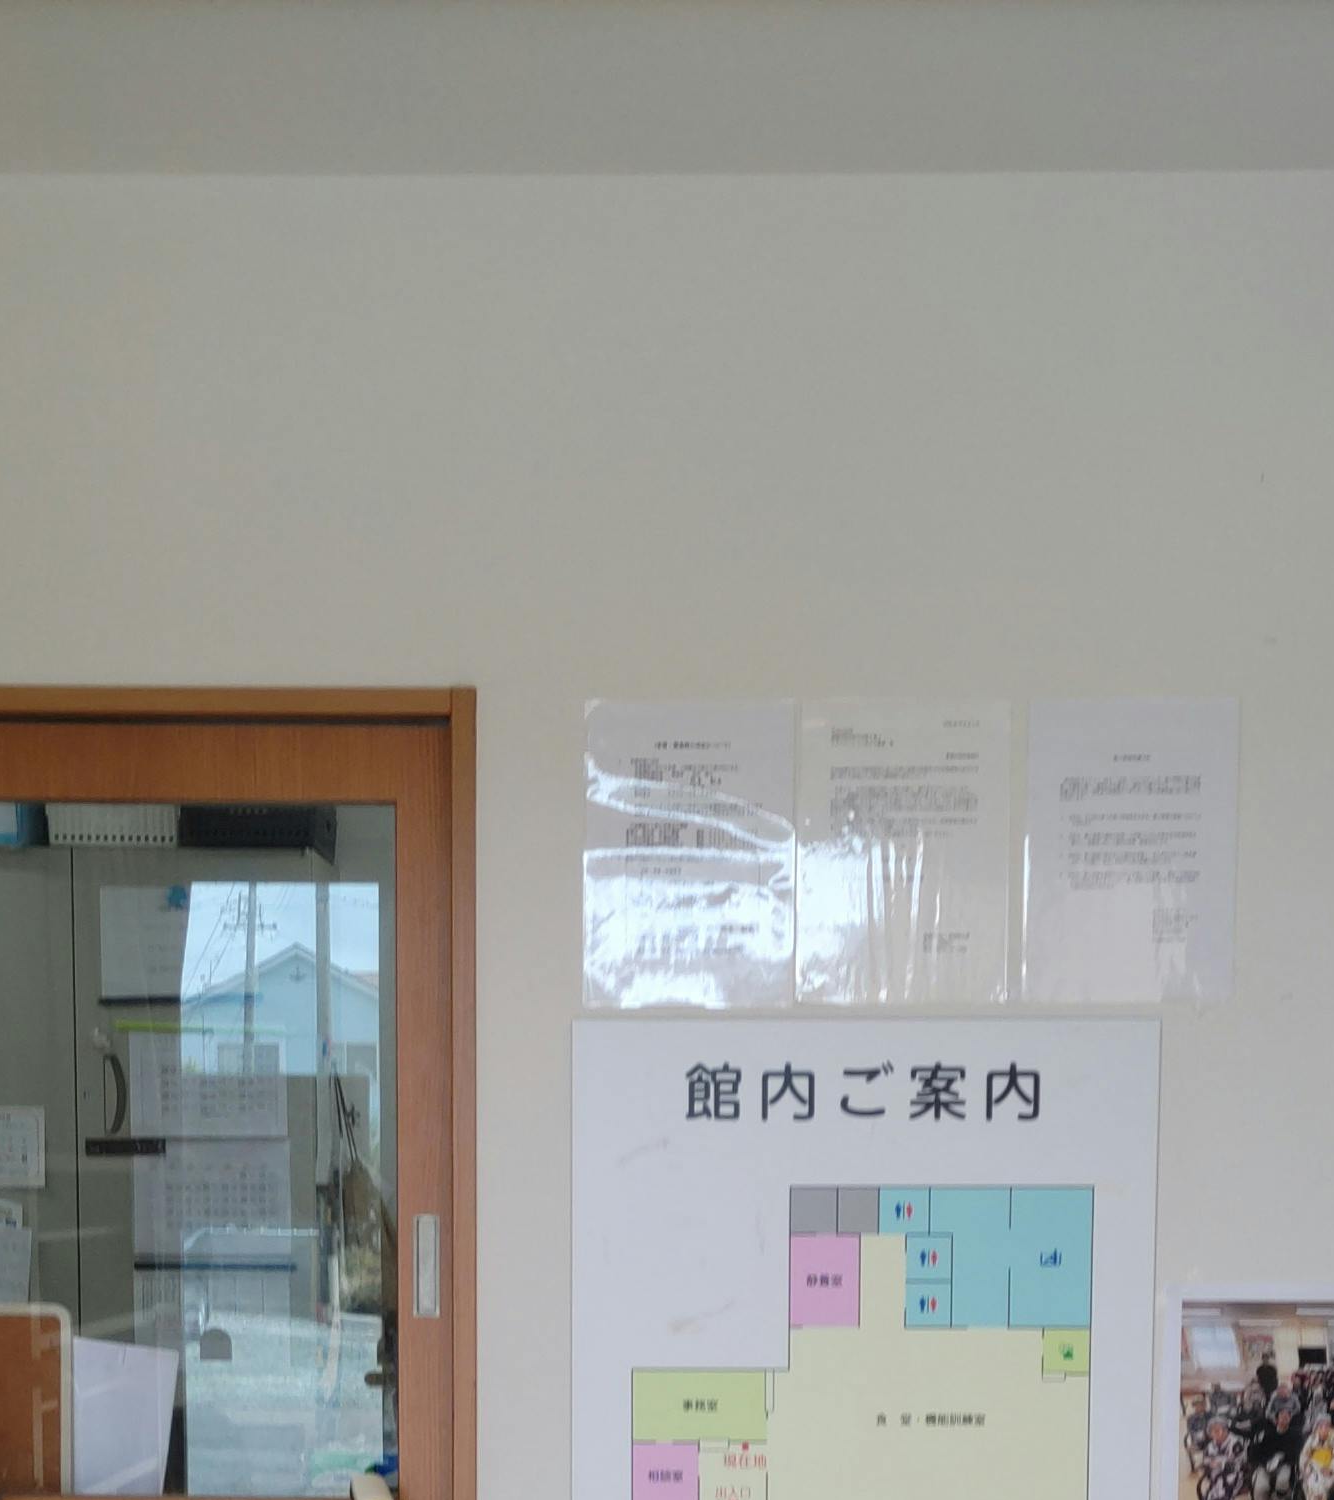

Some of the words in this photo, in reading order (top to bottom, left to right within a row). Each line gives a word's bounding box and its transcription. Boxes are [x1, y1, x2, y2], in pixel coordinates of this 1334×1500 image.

[685, 1060, 1041, 1122] 館内ご案内
